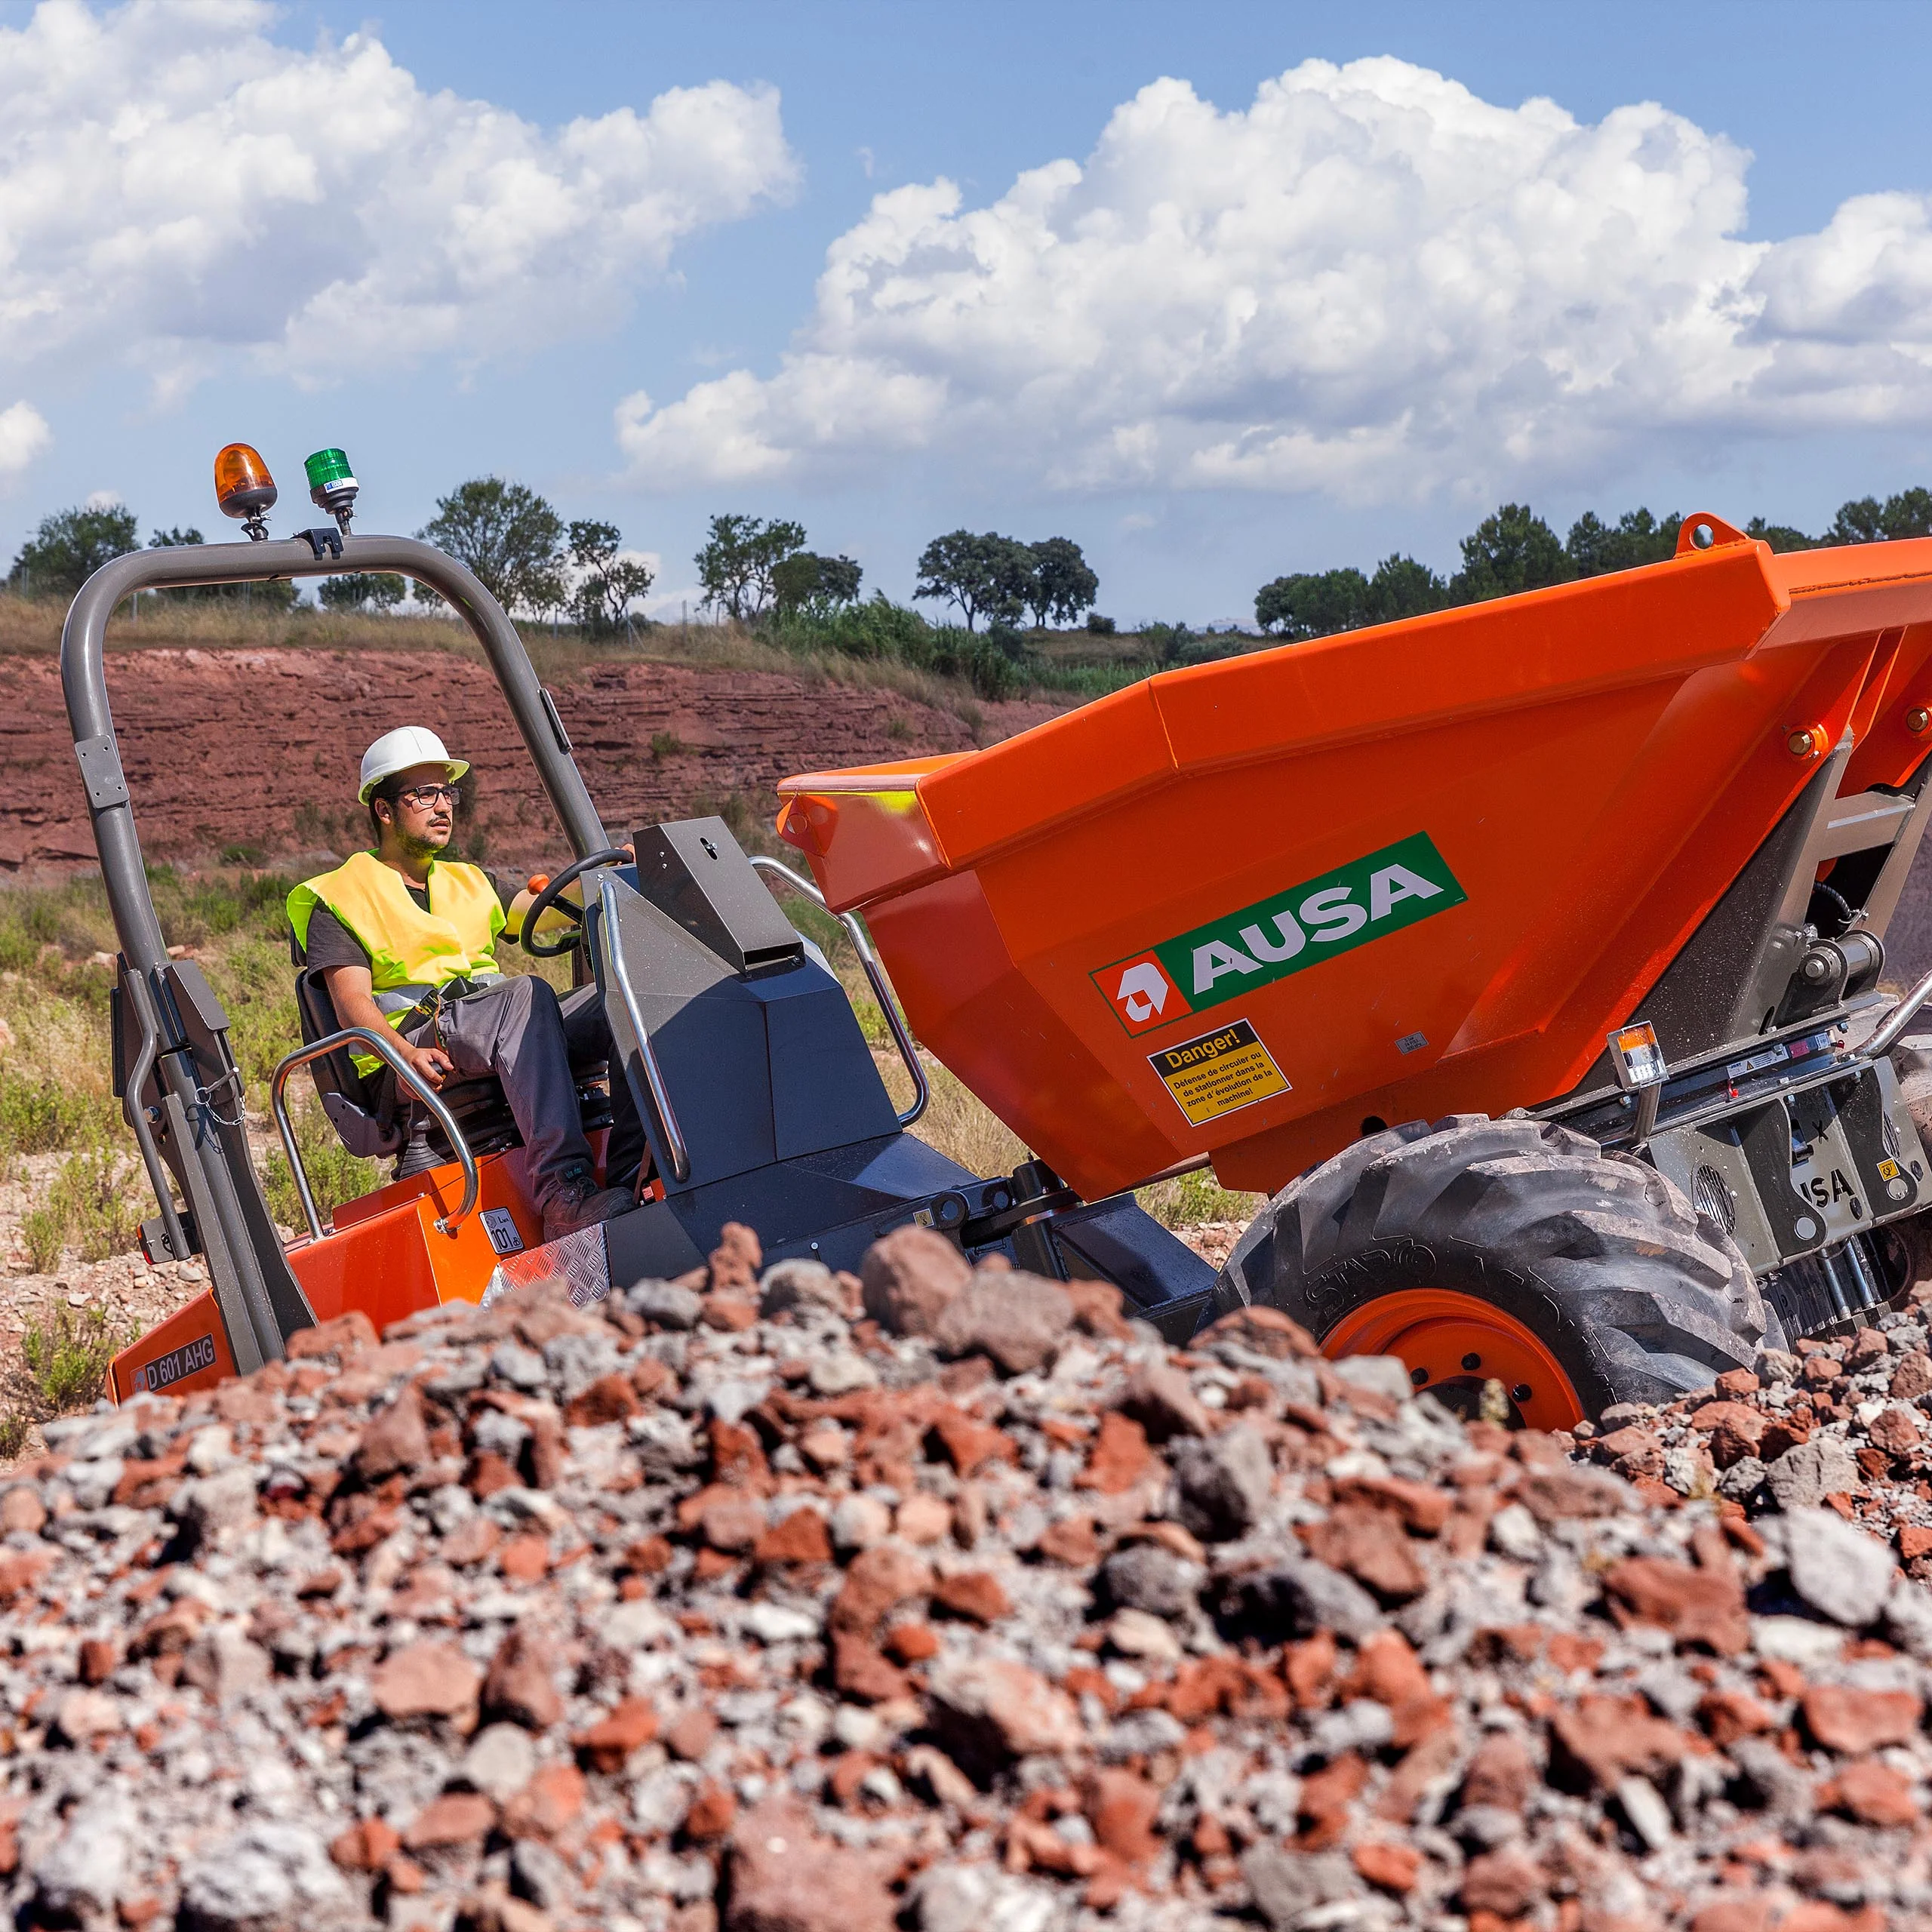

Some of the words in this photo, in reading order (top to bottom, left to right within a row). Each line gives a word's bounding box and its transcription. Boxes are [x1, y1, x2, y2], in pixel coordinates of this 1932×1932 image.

[1193, 864, 1444, 995] AUSA
[1165, 1029, 1241, 1069] Danger!
[1174, 1073, 1206, 1090] Défense
[1208, 1066, 1218, 1076] de
[1220, 1057, 1249, 1072] circuler
[1251, 1051, 1262, 1060] ou
[1183, 1087, 1194, 1097] de
[1195, 1075, 1234, 1094] stationner
[1235, 1065, 1256, 1077] dans
[1257, 1061, 1265, 1069] la
[1186, 1096, 1206, 1107] zone
[1253, 1072, 1263, 1082] de
[1264, 1069, 1273, 1078] la
[1217, 1088, 1254, 1107] machine!
[491, 1227, 513, 1249] 101
[146, 1365, 158, 1389] D
[159, 1354, 181, 1383] 601
[185, 1339, 214, 1373] AHG
